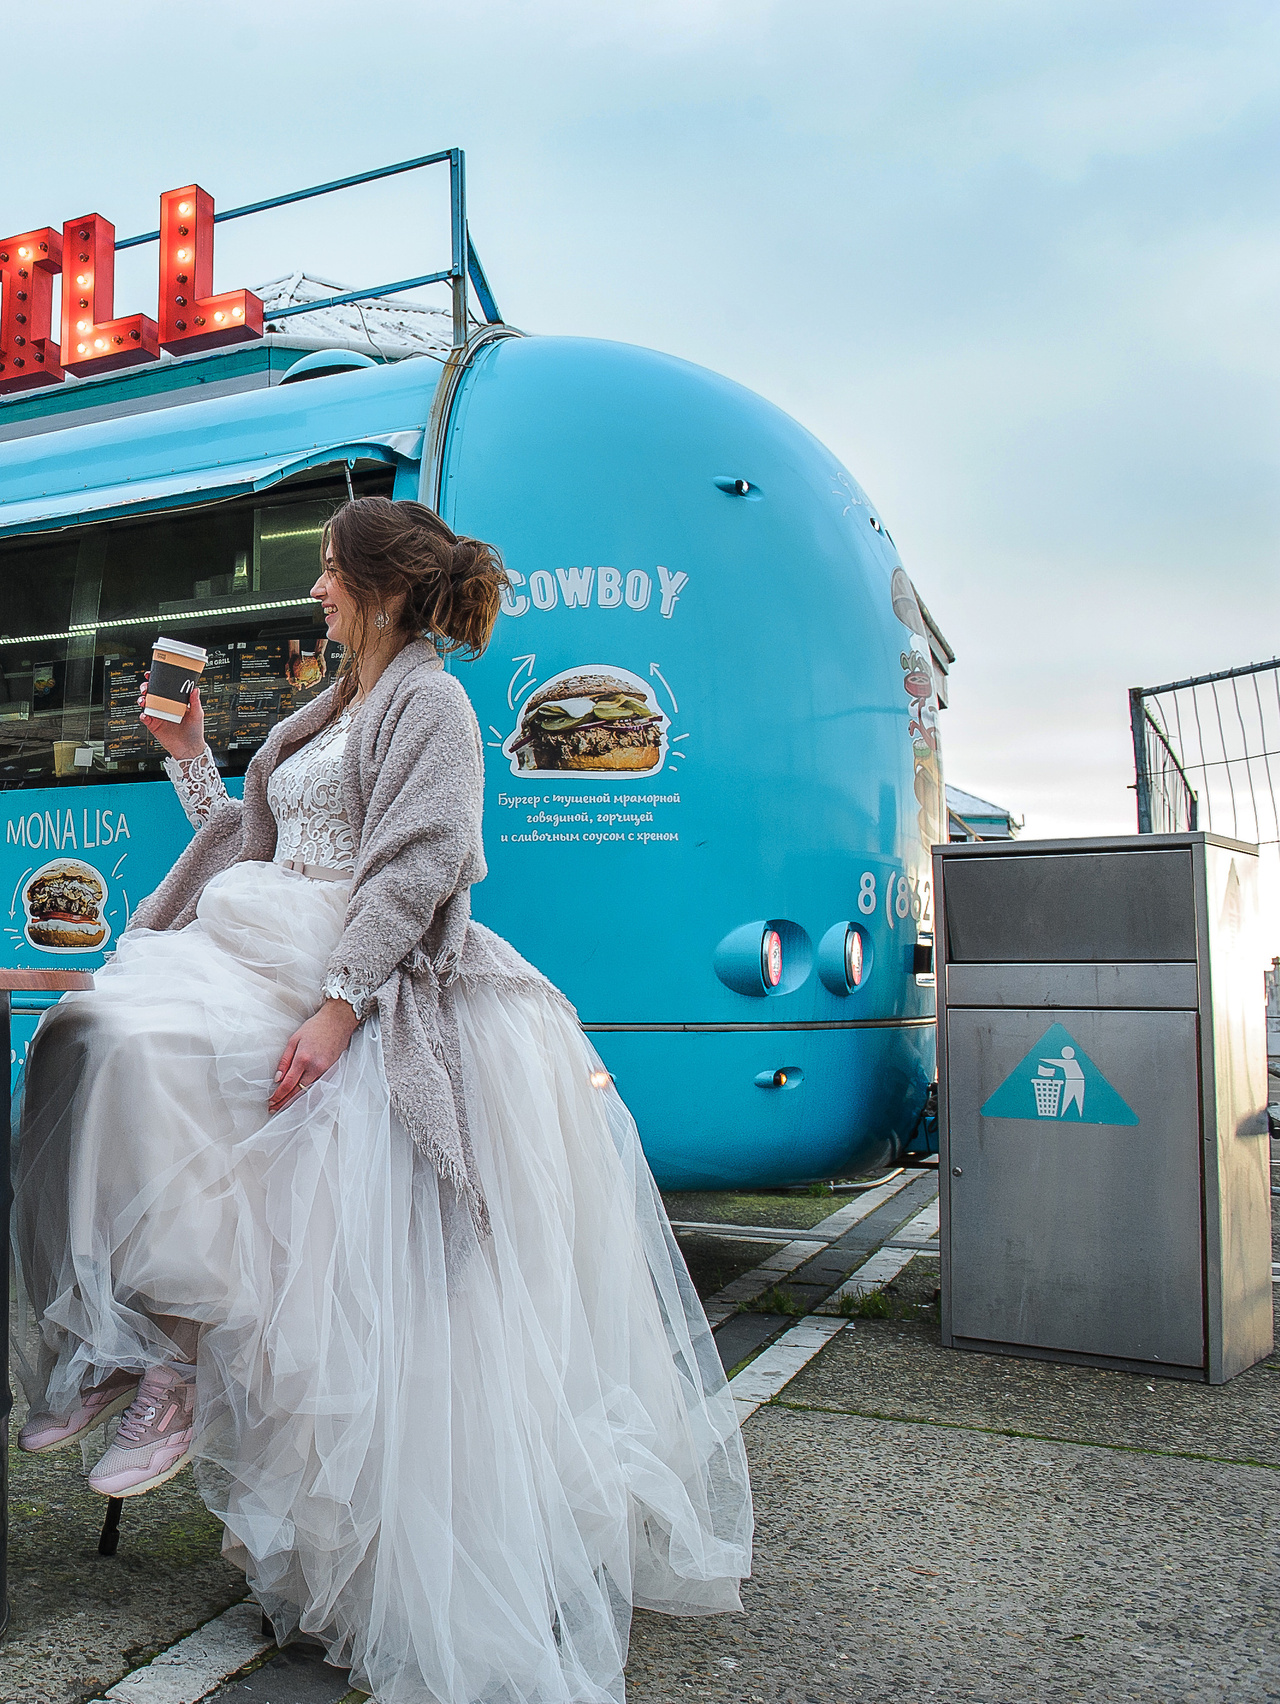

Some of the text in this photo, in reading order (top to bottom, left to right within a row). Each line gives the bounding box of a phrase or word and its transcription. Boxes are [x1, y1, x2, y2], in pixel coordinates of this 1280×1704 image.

[499, 565, 689, 618] COWBOY
[498, 792, 681, 808] Бургер с тушеной мраморной
[6, 808, 131, 850] MONA LISA
[526, 811, 653, 827] говядиной, горчицей
[500, 830, 679, 845] и сливочным соусом с хреном
[858, 871, 877, 915] 8
